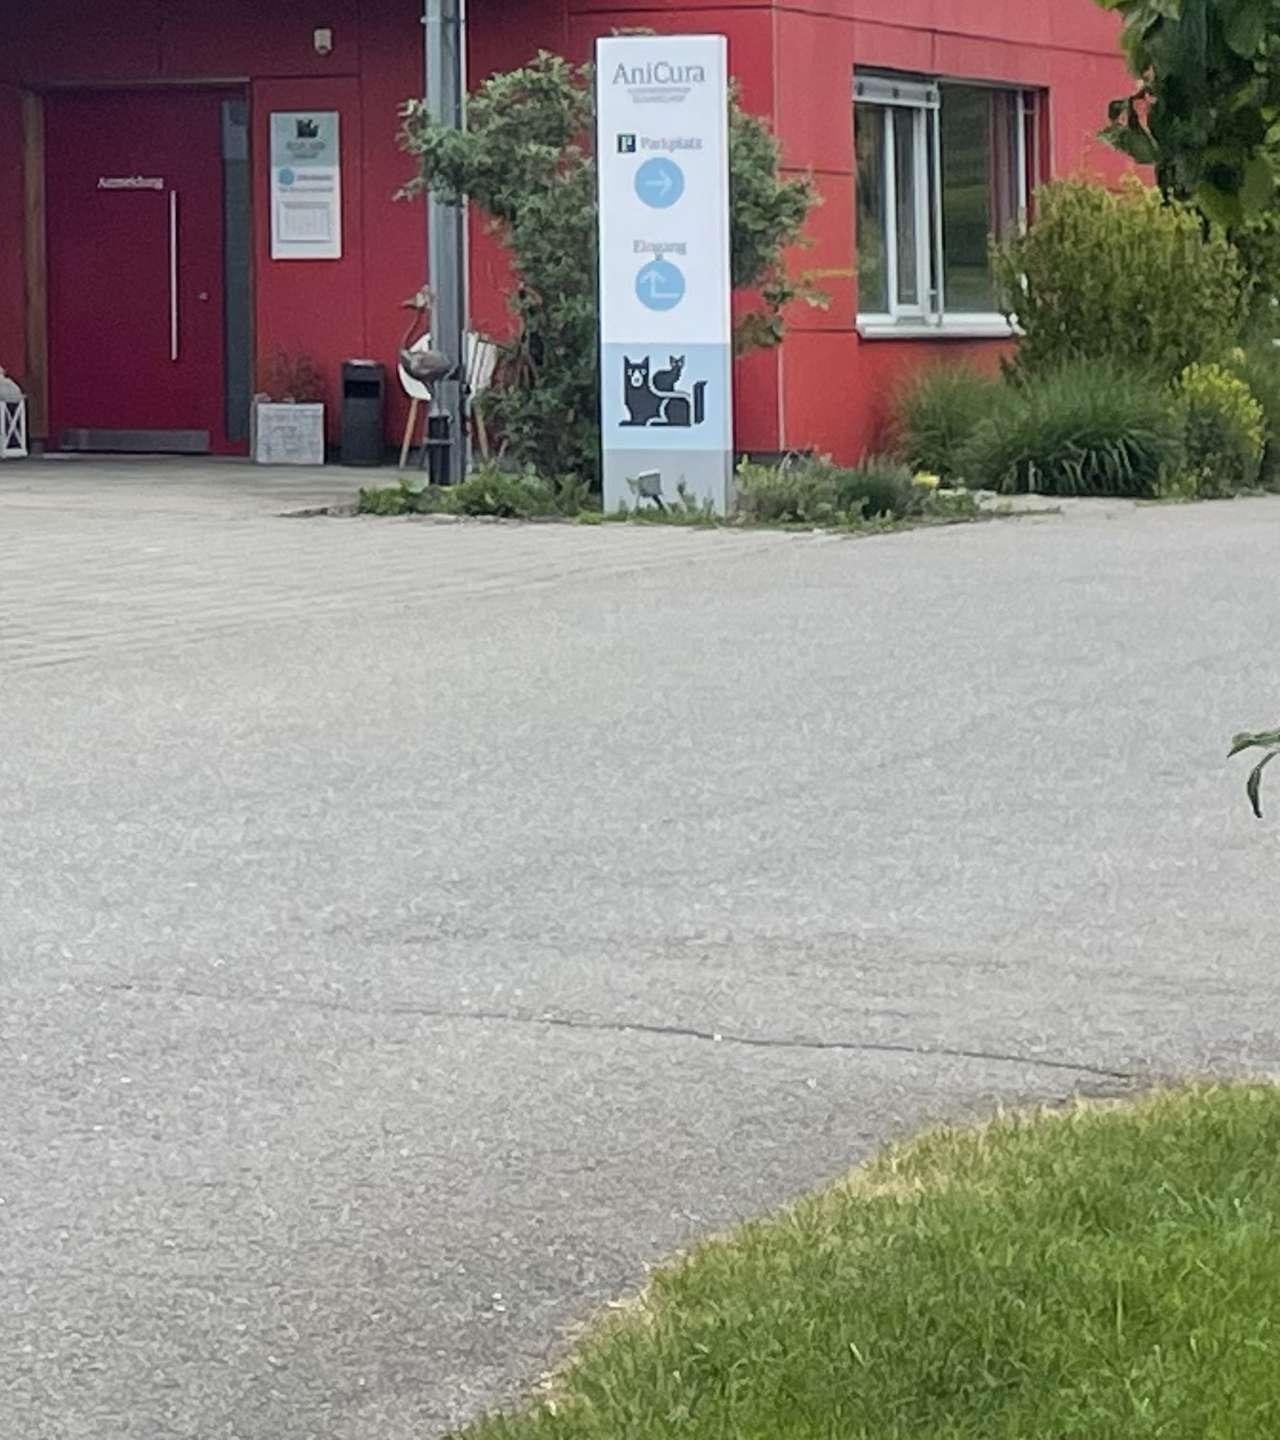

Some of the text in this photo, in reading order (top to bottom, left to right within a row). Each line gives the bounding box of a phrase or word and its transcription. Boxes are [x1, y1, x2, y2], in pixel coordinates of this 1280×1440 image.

[612, 61, 705, 84] AniCura
[641, 136, 702, 152] Parkplatz
[96, 175, 164, 190] Anmeldung
[632, 239, 687, 258] Eingang
